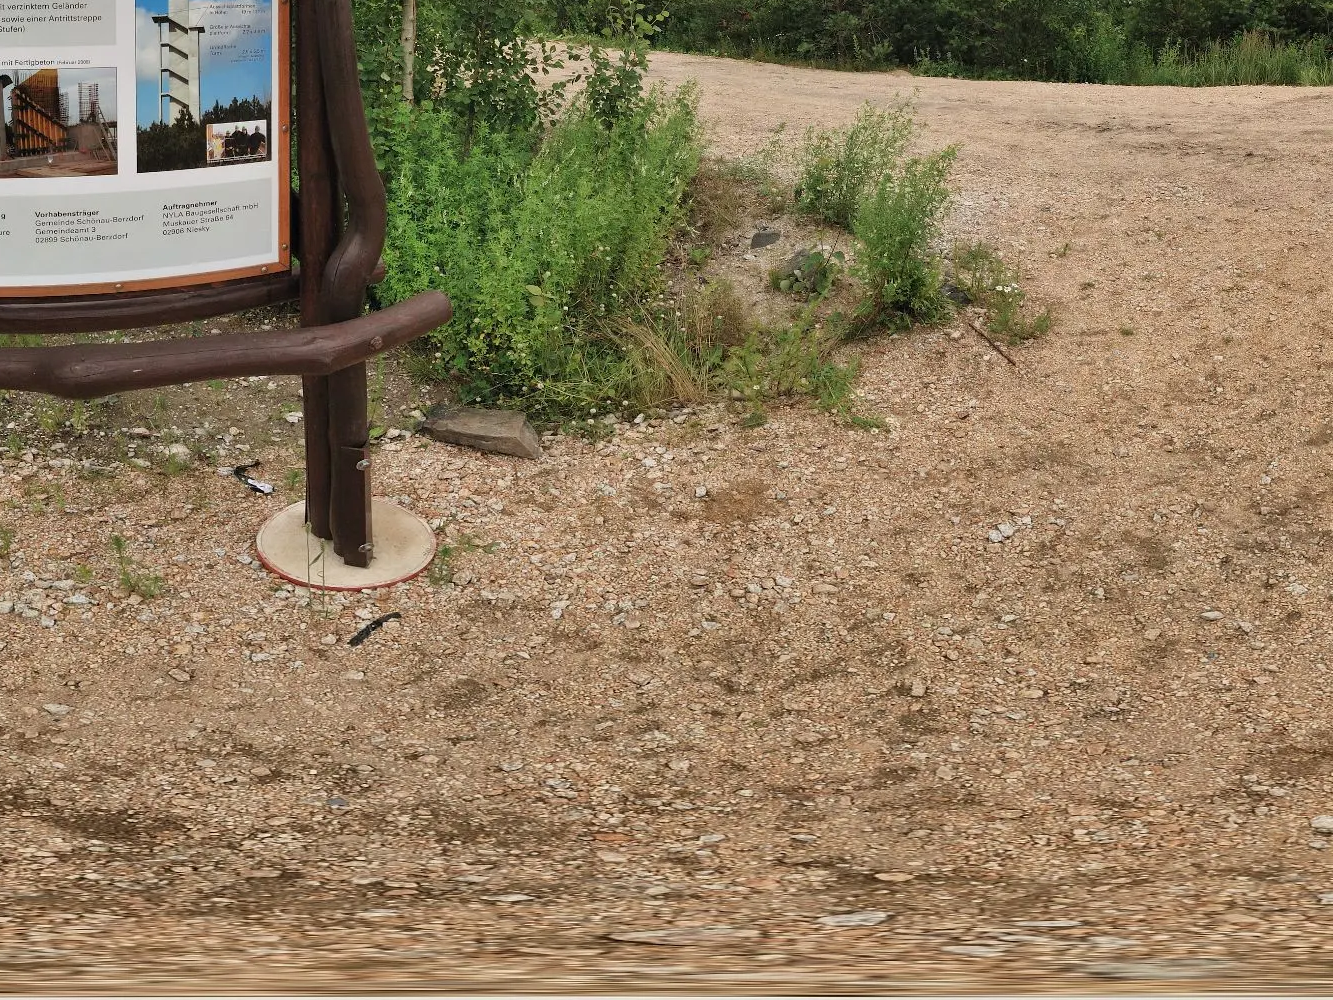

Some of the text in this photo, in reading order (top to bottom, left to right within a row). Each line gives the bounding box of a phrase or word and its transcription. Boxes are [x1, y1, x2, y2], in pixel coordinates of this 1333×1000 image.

[52, 2, 88, 10] Geländer
[48, 15, 102, 23] Antrittstreppe
[15, 59, 55, 67] Fertigbeton
[162, 201, 218, 211] Auftragnehmer
[34, 210, 99, 218] Vorhabensträger
[163, 202, 259, 219] NYLA Baugesellschaft mbH
[35, 215, 145, 227] Gemeinde Schönau-Berzdorf
[163, 219, 198, 227] Muskauer
[200, 216, 224, 224] Straße
[35, 227, 89, 235] Gemeindeamt
[186, 225, 210, 233] Niesky
[60, 232, 128, 243] Schönau-Berzdorf
